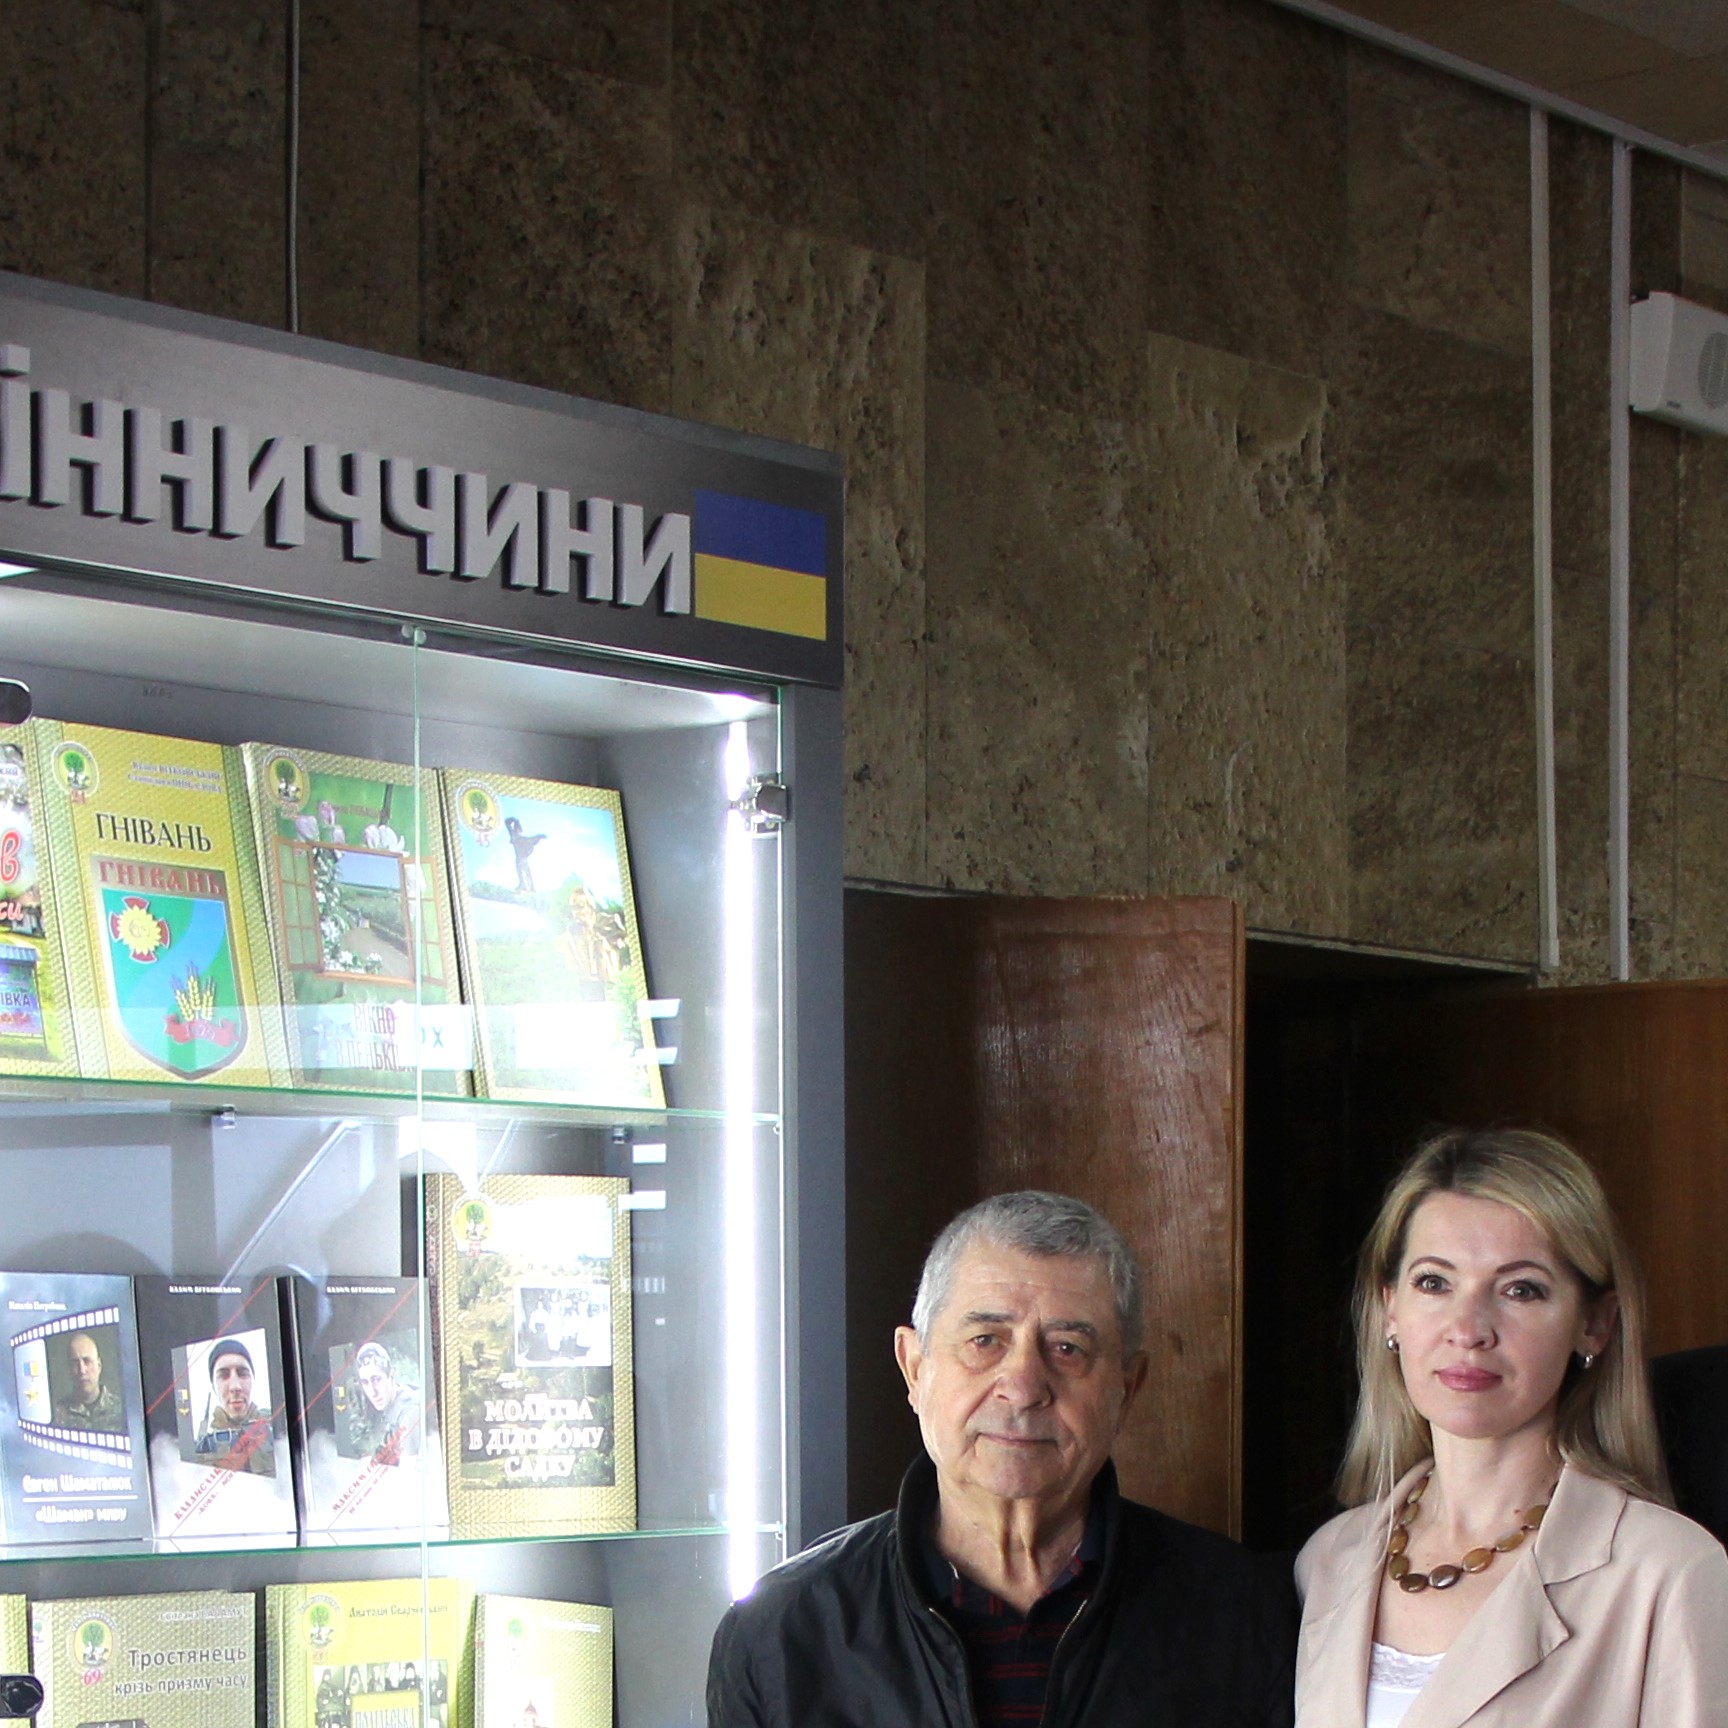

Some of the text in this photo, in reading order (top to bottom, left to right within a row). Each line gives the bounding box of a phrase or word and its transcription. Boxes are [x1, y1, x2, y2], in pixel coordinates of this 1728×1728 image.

[94, 811, 213, 853] ГНІВАНЬ
[98, 860, 223, 895] ГНІВАНЬ
[484, 1397, 594, 1422] МОЛИТВА
[468, 1426, 605, 1457] В ДІДОВОМУ
[503, 1452, 575, 1483] САДКУ
[128, 1646, 248, 1671] Тростянець
[115, 1673, 249, 1697] крізь призму часу
